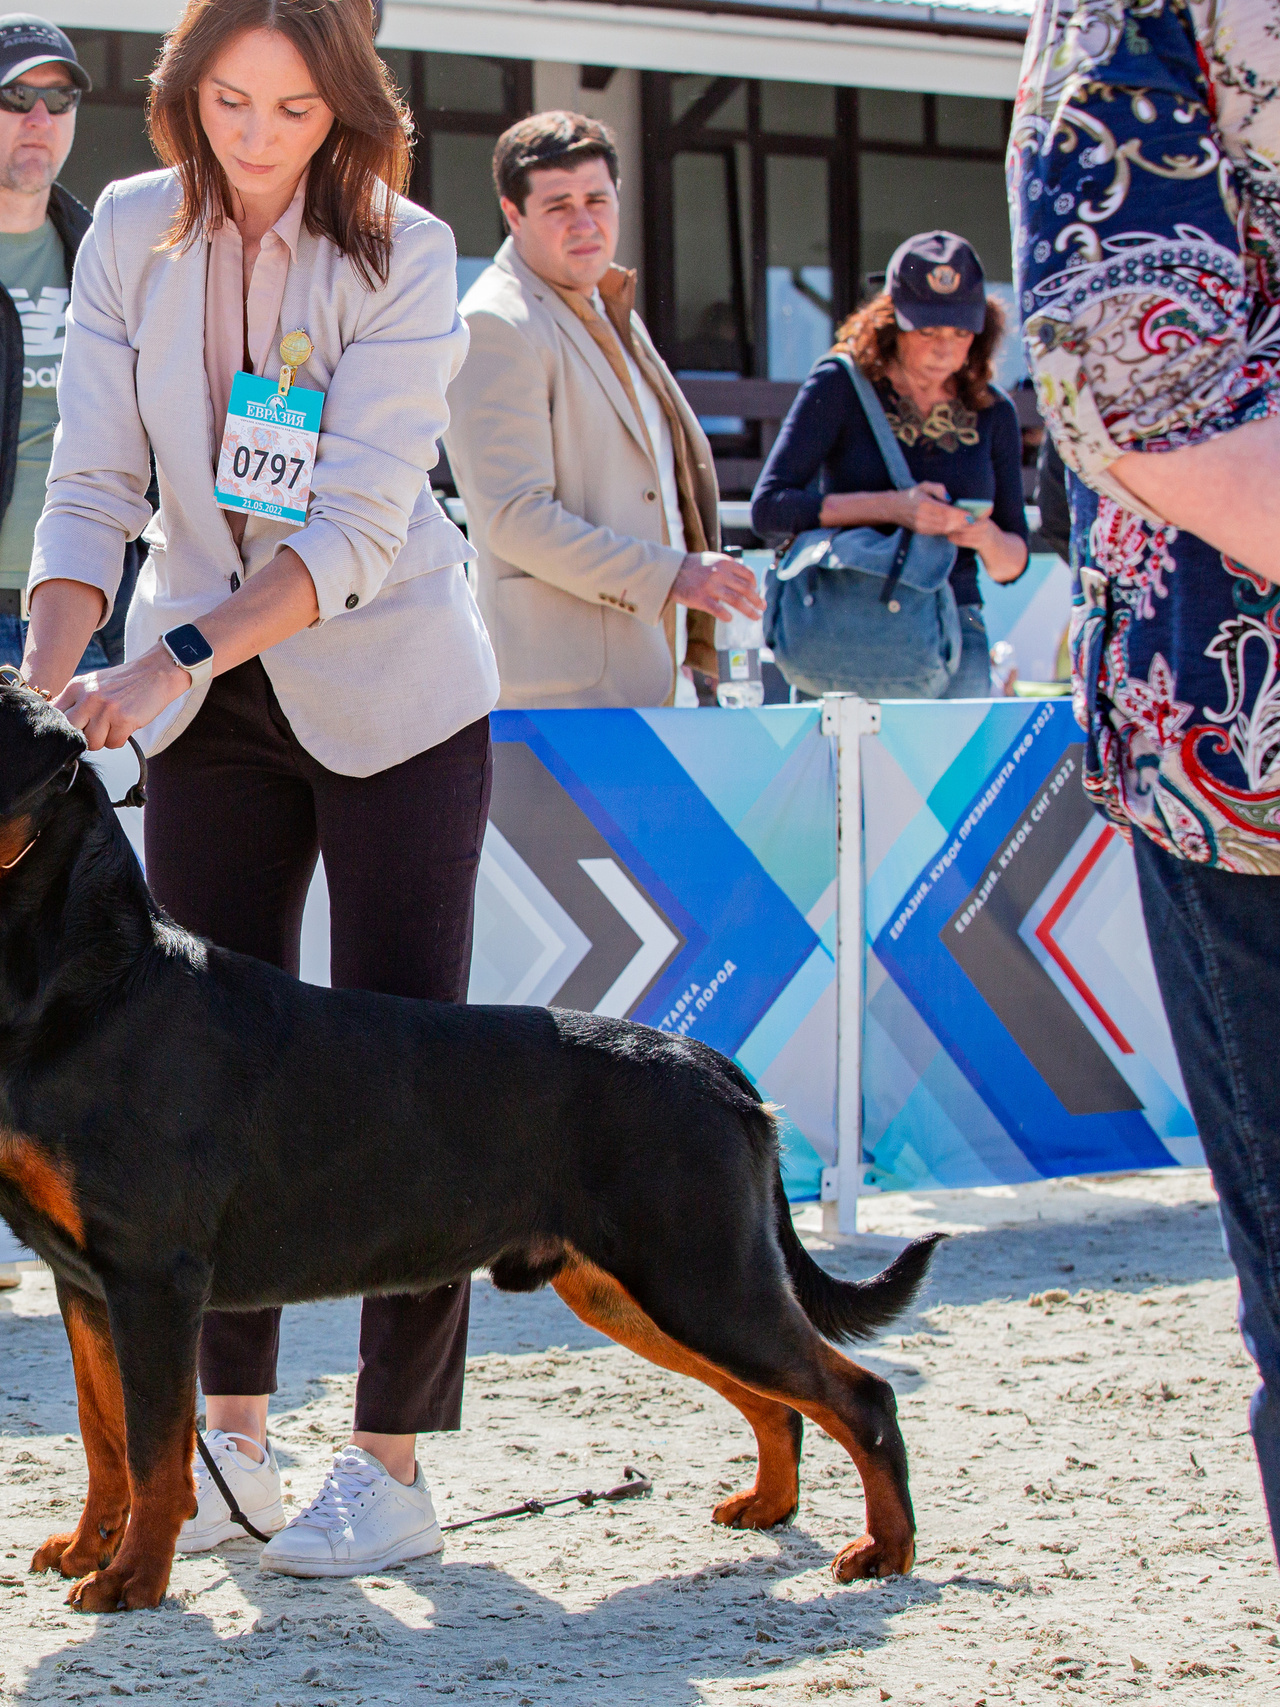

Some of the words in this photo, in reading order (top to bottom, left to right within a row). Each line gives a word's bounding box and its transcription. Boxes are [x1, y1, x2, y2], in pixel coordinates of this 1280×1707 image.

[245, 404, 306, 428] ЕВРАЗИЯ
[233, 445, 305, 489] 0797
[242, 498, 283, 516] 21.05.2022
[888, 881, 932, 941] ЕВРАЗИЯ.
[929, 838, 963, 883] КУБОК
[958, 761, 1016, 841] ПРЕЗИДЕНТА
[954, 870, 1002, 934] ЕВРАЗИЯ.
[998, 819, 1033, 869] КУБОК
[1030, 792, 1052, 822] СНГ
[1048, 758, 1076, 796] 2022
[677, 1011, 697, 1035] ИХ
[695, 959, 738, 1012] ПОРОД
